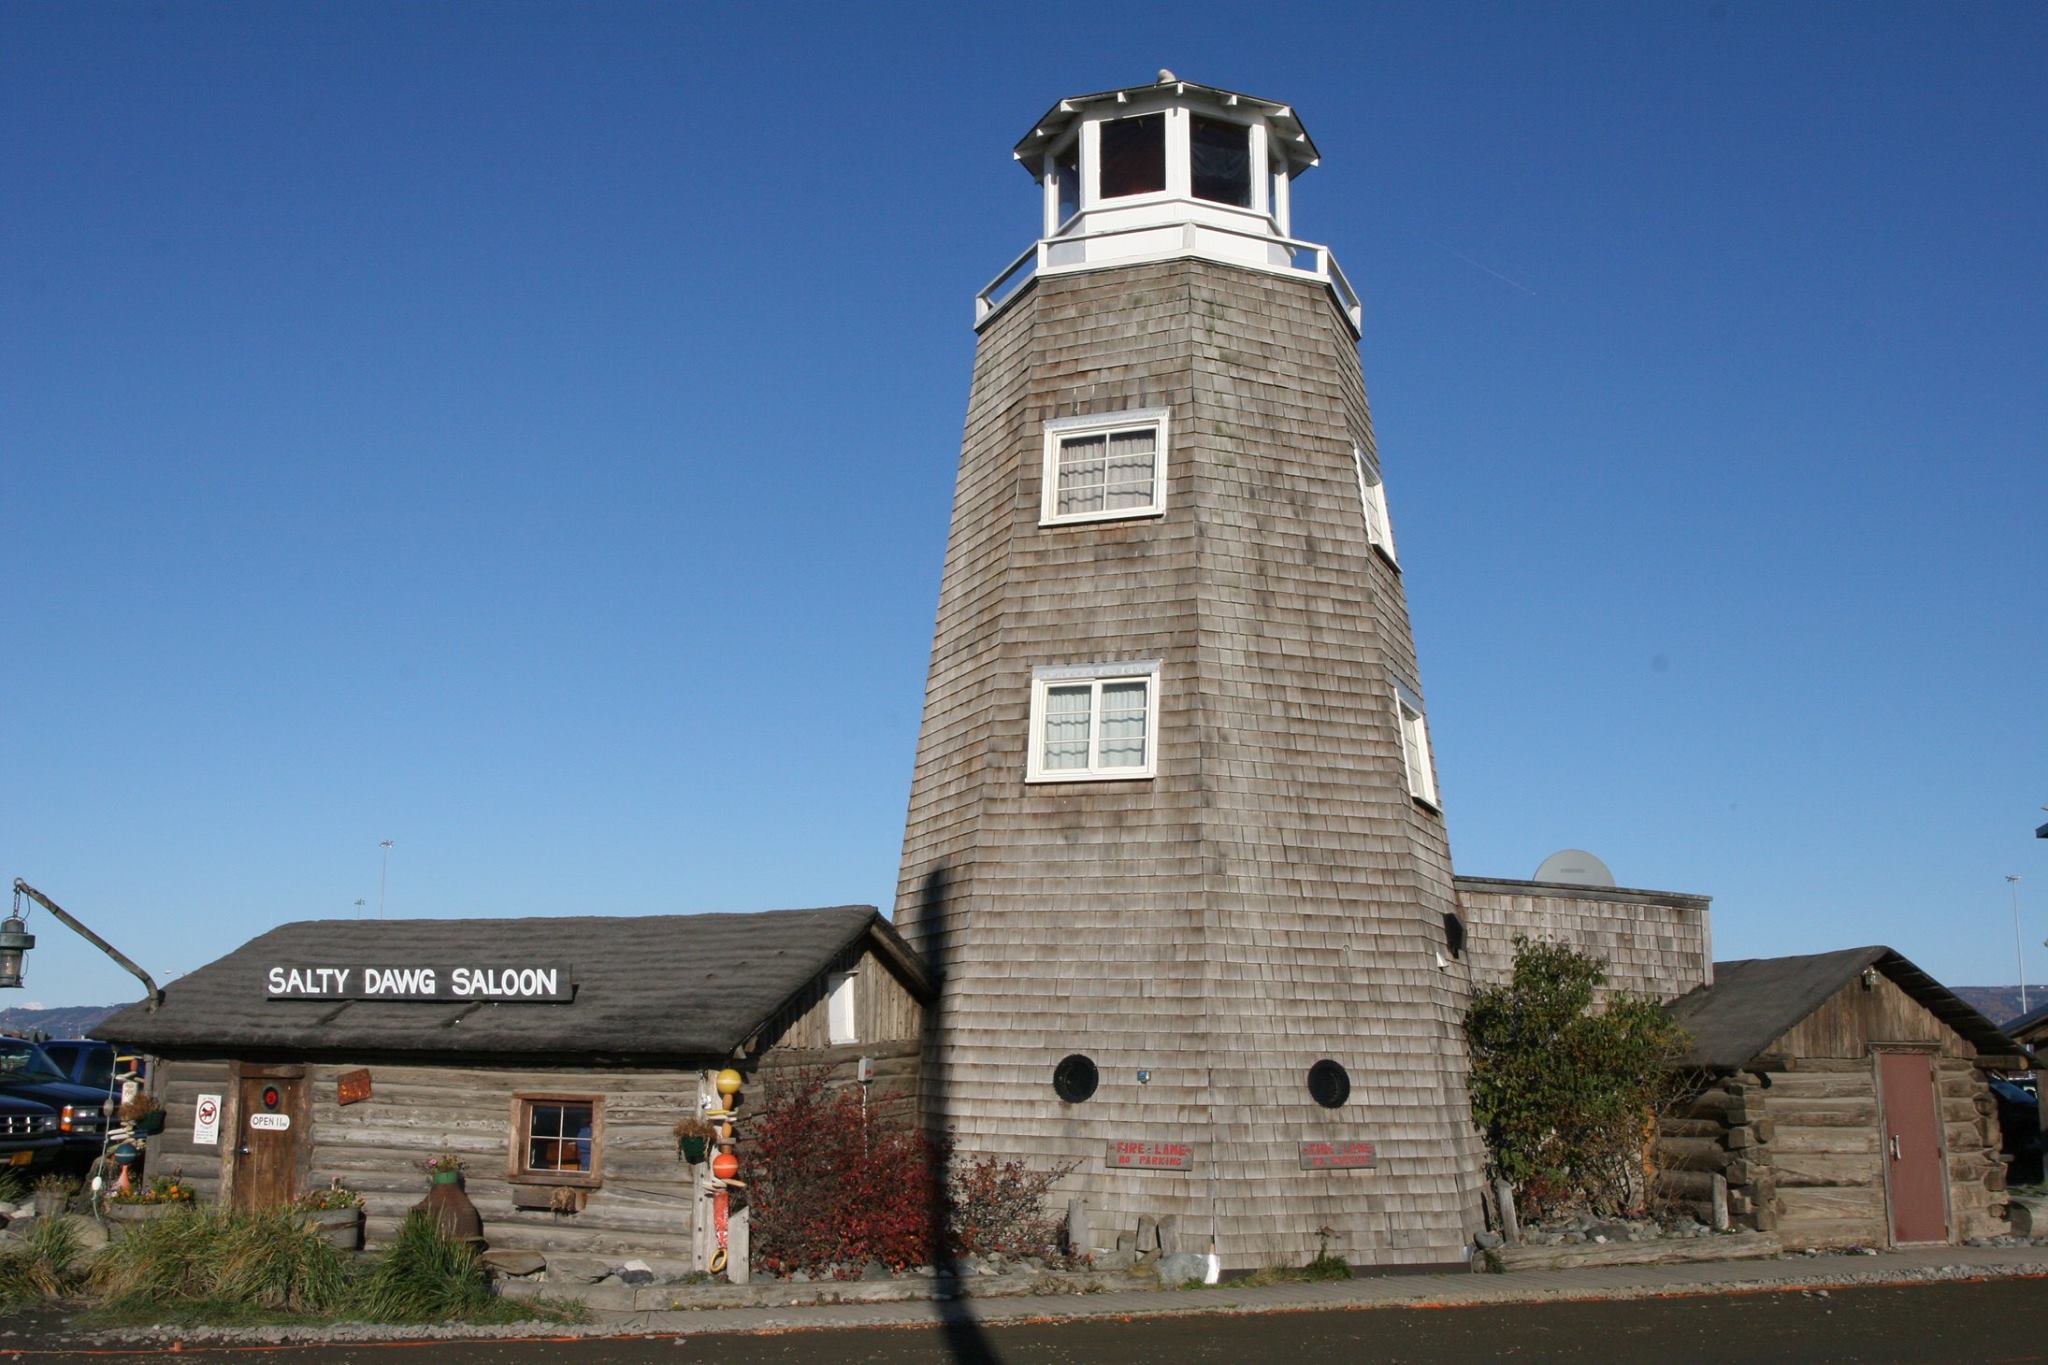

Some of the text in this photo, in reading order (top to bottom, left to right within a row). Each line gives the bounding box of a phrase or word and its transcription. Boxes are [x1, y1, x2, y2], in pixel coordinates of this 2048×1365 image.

[268, 966, 557, 996] SALTY DAWG SALOON
[252, 1116, 274, 1126] OPEN
[1115, 1141, 1186, 1156] FIRE LANE
[1118, 1155, 1182, 1166] NO PARKING
